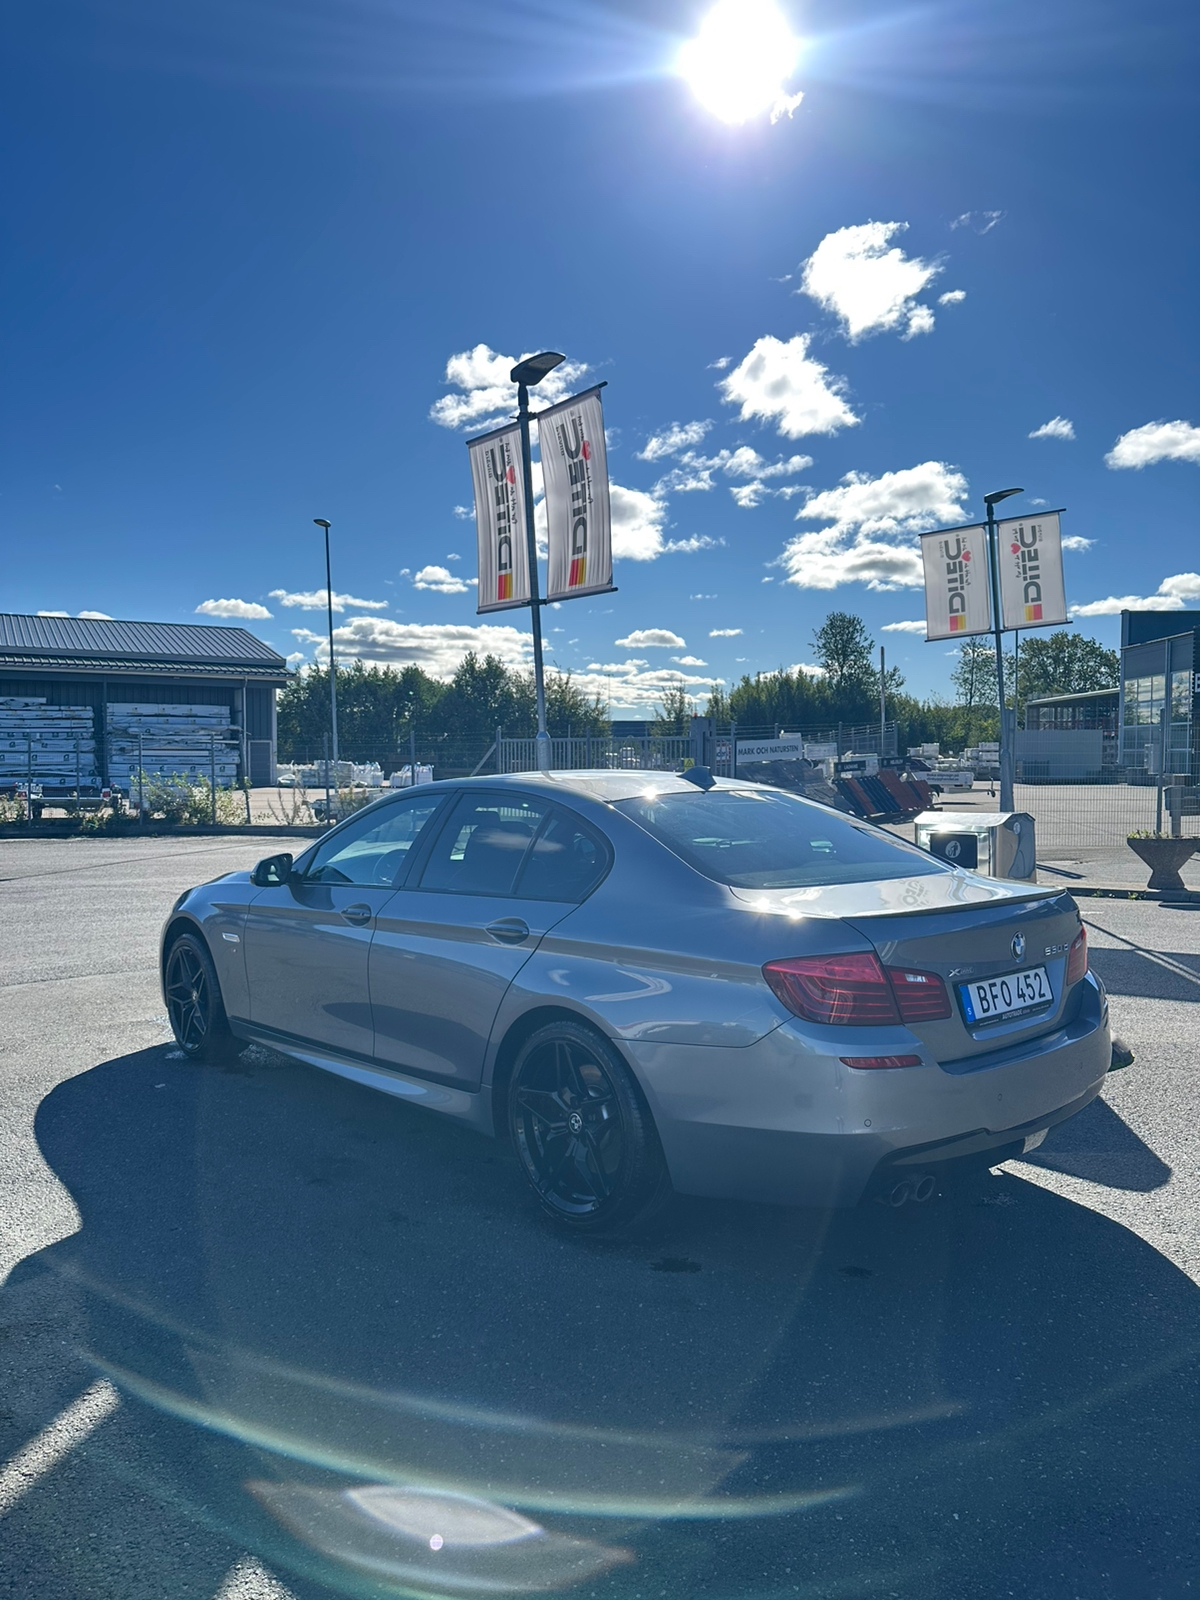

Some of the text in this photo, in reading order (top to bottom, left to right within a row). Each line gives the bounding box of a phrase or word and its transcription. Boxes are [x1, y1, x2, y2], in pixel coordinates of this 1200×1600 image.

[737, 747, 755, 756] MARK
[756, 746, 769, 755] OCH
[769, 744, 799, 754] NATURSTEN
[976, 972, 1046, 1014] BFO 452
